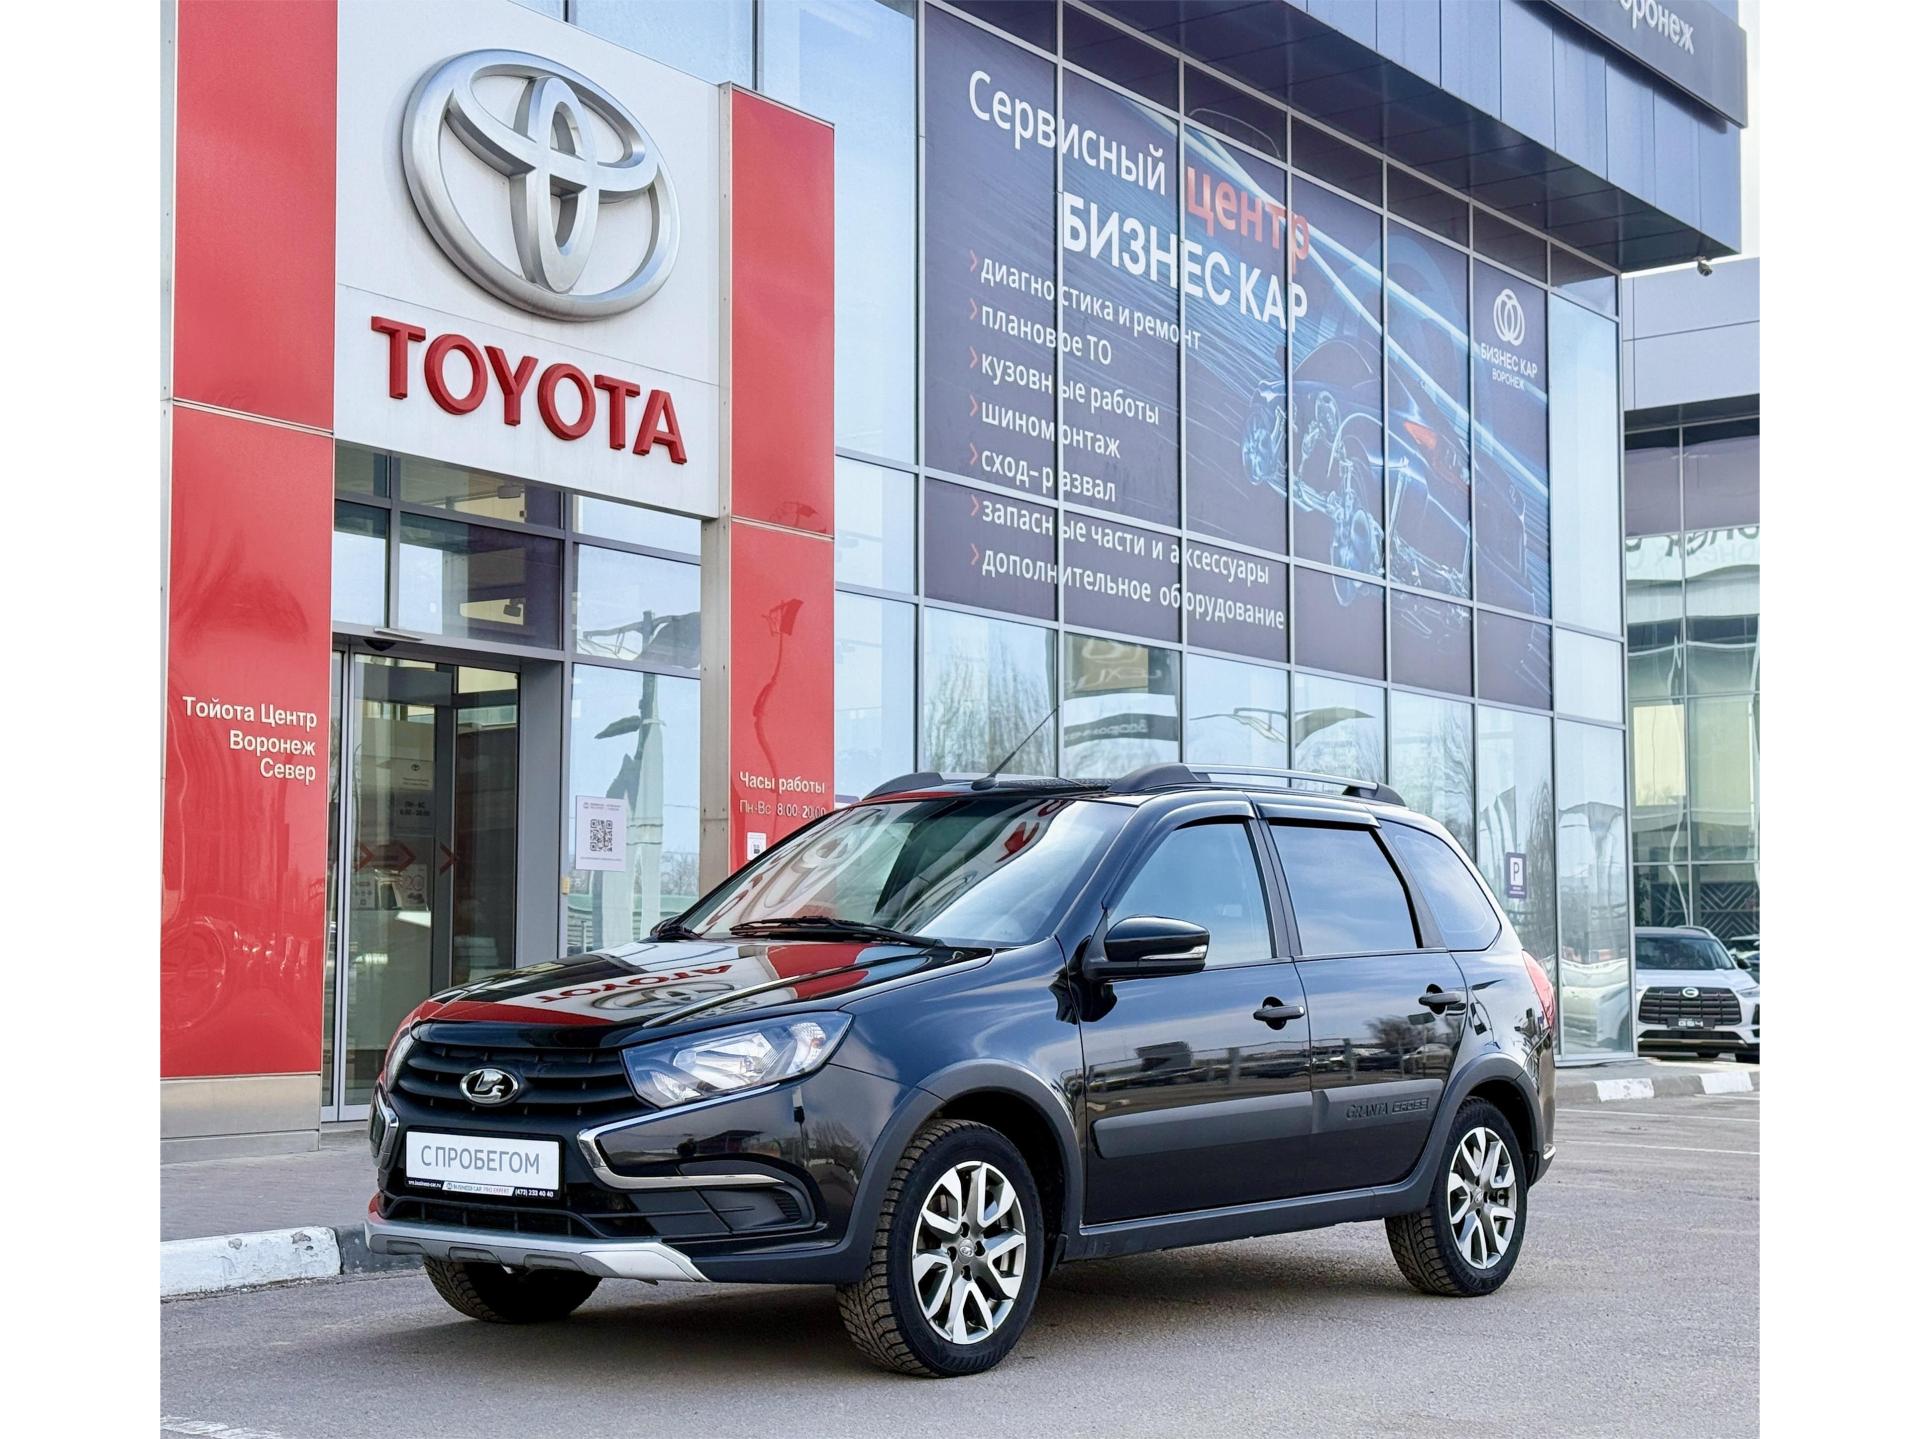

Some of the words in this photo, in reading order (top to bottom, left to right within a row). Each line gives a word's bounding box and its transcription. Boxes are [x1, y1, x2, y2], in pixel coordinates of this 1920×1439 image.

[969, 70, 1166, 196] Сервисный
[1186, 166, 1310, 275] центр
[1063, 191, 1232, 306] БИЗНЕС
[1239, 262, 1308, 333] КАР
[980, 258, 1113, 322] диагностика
[1118, 305, 1130, 327] и
[1133, 311, 1202, 350] ремонт
[981, 305, 1082, 356] плановое
[1086, 335, 1112, 365] ТО
[1480, 342, 1519, 372] БИЗНЕС
[1520, 359, 1538, 378] КАР
[1492, 367, 1526, 391] ВОРОНЕЖ
[371, 316, 688, 465] TOYOTA
[981, 353, 1086, 402] кузовные
[1090, 387, 1159, 425] работы
[981, 401, 1121, 459] шиномонтаж
[982, 500, 1086, 543] запасные
[1091, 529, 1145, 557] части
[1152, 538, 1163, 561] и
[1170, 543, 1269, 587] аксессуары
[982, 549, 1151, 602] дополнительное
[1159, 583, 1284, 630] оборудование
[182, 696, 255, 722] Тойота
[260, 703, 317, 732] Центр
[229, 729, 316, 757] Воронеж
[260, 757, 317, 785] Север
[739, 770, 775, 790] Часы
[778, 776, 826, 795] работы
[1513, 861, 1520, 881] P
[1346, 1102, 1388, 1119] GRANTA
[1392, 1098, 1430, 1114] CROSS
[421, 1145, 432, 1167] С
[434, 1146, 541, 1175] ПРОБЕГОМ
